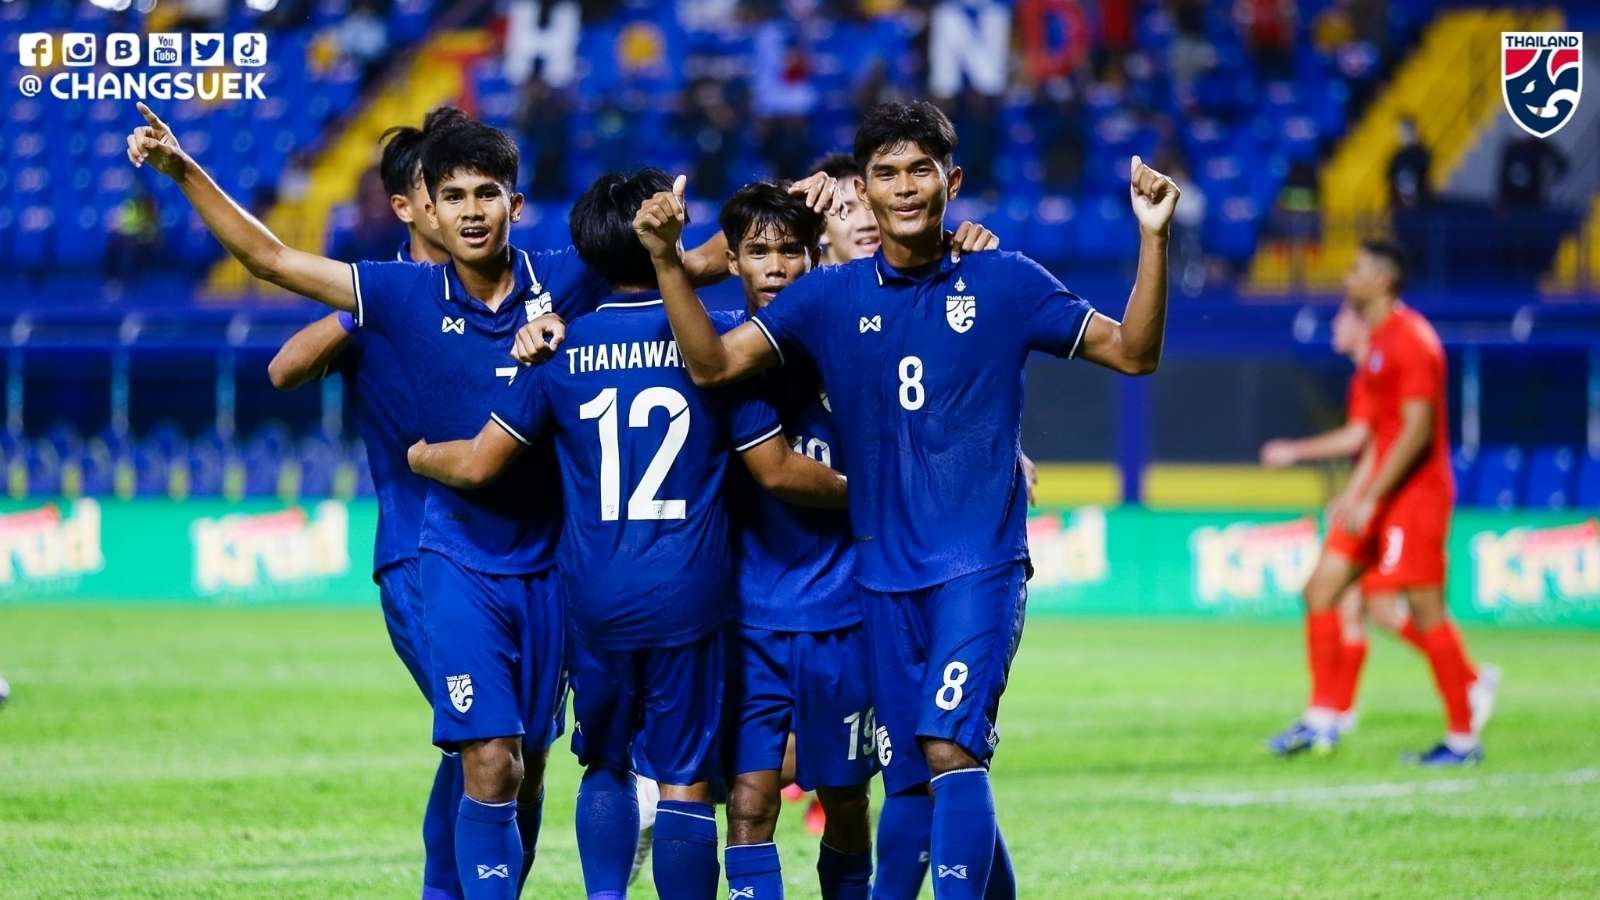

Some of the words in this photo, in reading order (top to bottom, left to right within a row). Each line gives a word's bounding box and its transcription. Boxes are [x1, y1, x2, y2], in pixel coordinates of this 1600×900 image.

[566, 340, 686, 374] THANAWA
[898, 355, 925, 411] 8
[579, 387, 691, 521] 12
[935, 661, 968, 711] 8
[843, 706, 876, 761] 19
